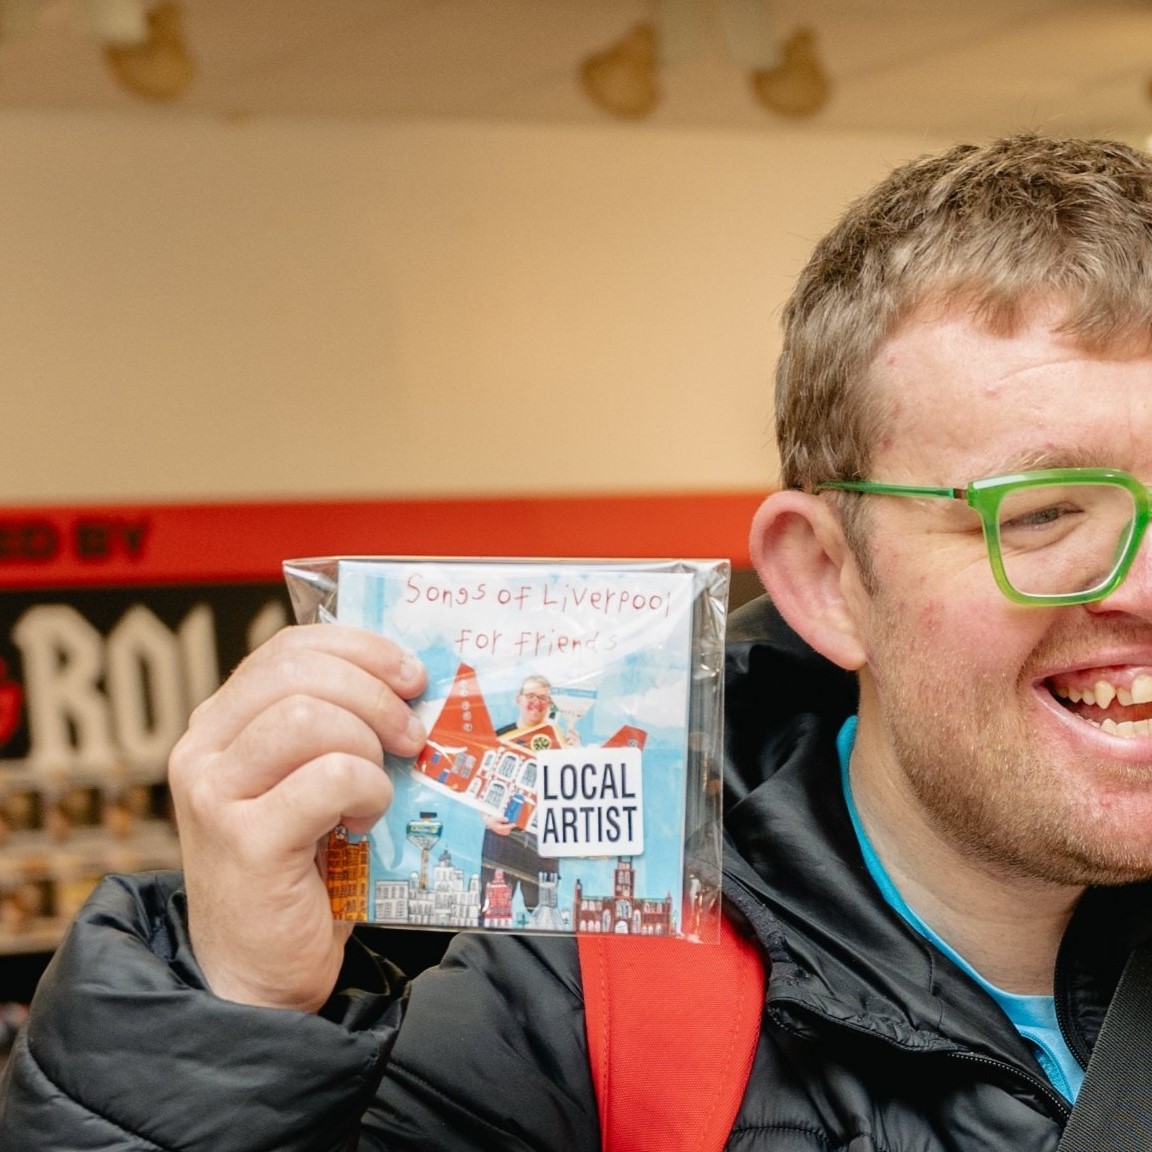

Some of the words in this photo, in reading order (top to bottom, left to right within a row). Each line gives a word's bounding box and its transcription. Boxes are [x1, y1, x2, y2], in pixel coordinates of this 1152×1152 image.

[72, 516, 152, 563] BY
[406, 574, 487, 607] Songs
[543, 584, 671, 617] Liverpool
[543, 763, 636, 800] LOCAL
[542, 806, 637, 843] ARTIST
